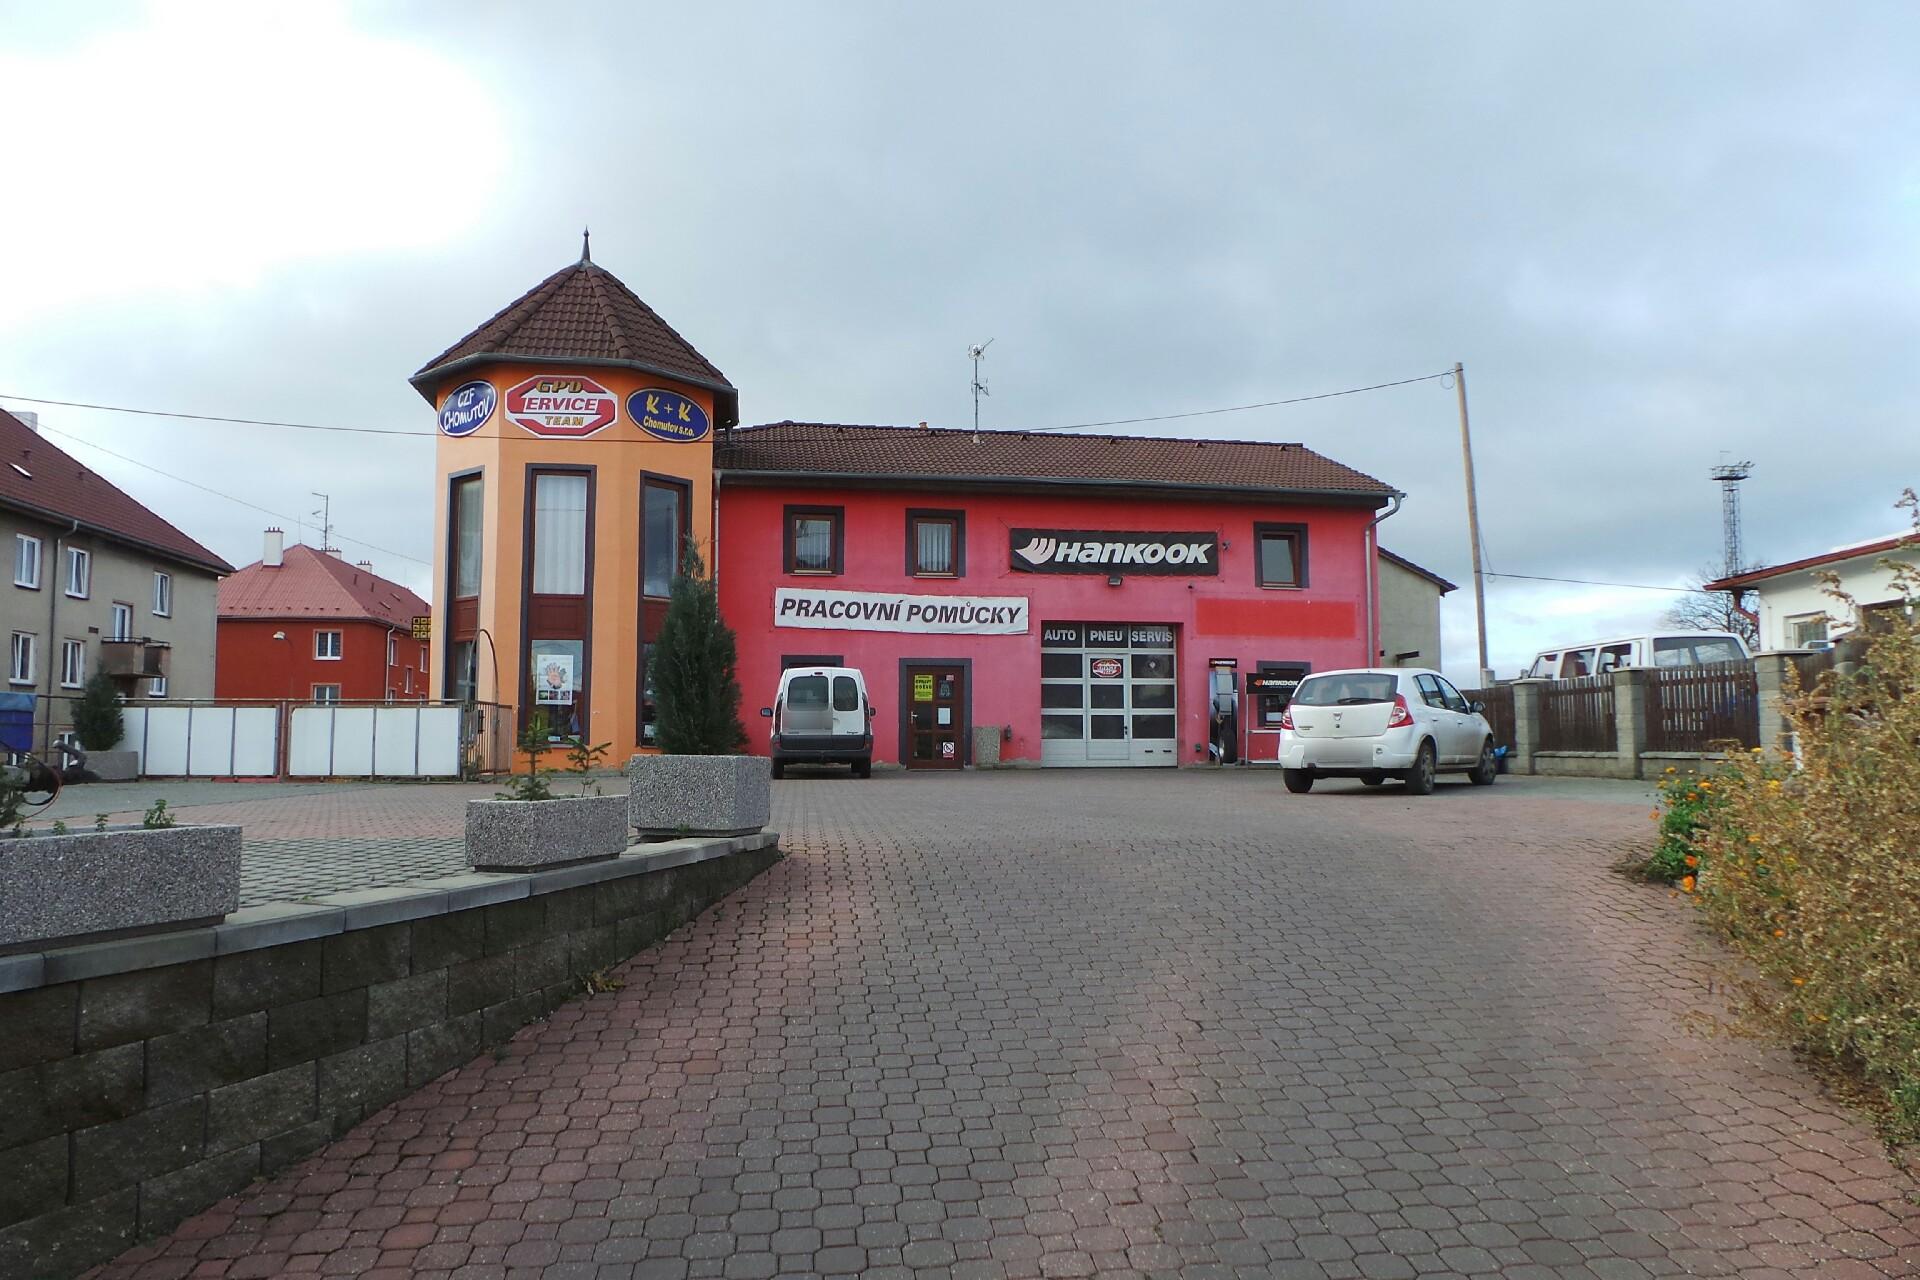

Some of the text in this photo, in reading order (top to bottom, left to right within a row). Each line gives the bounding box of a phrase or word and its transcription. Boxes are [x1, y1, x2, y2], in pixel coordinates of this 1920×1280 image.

[535, 379, 583, 393] GPD
[458, 387, 476, 408] CZF
[444, 396, 490, 431] CHOMUTOV
[545, 416, 583, 426] TEAM
[643, 415, 678, 434] Chomutov
[780, 598, 1021, 625] PRACOVNÍ POMŮCKY
[1044, 629, 1173, 642] AUTO PNEU SERVIS
